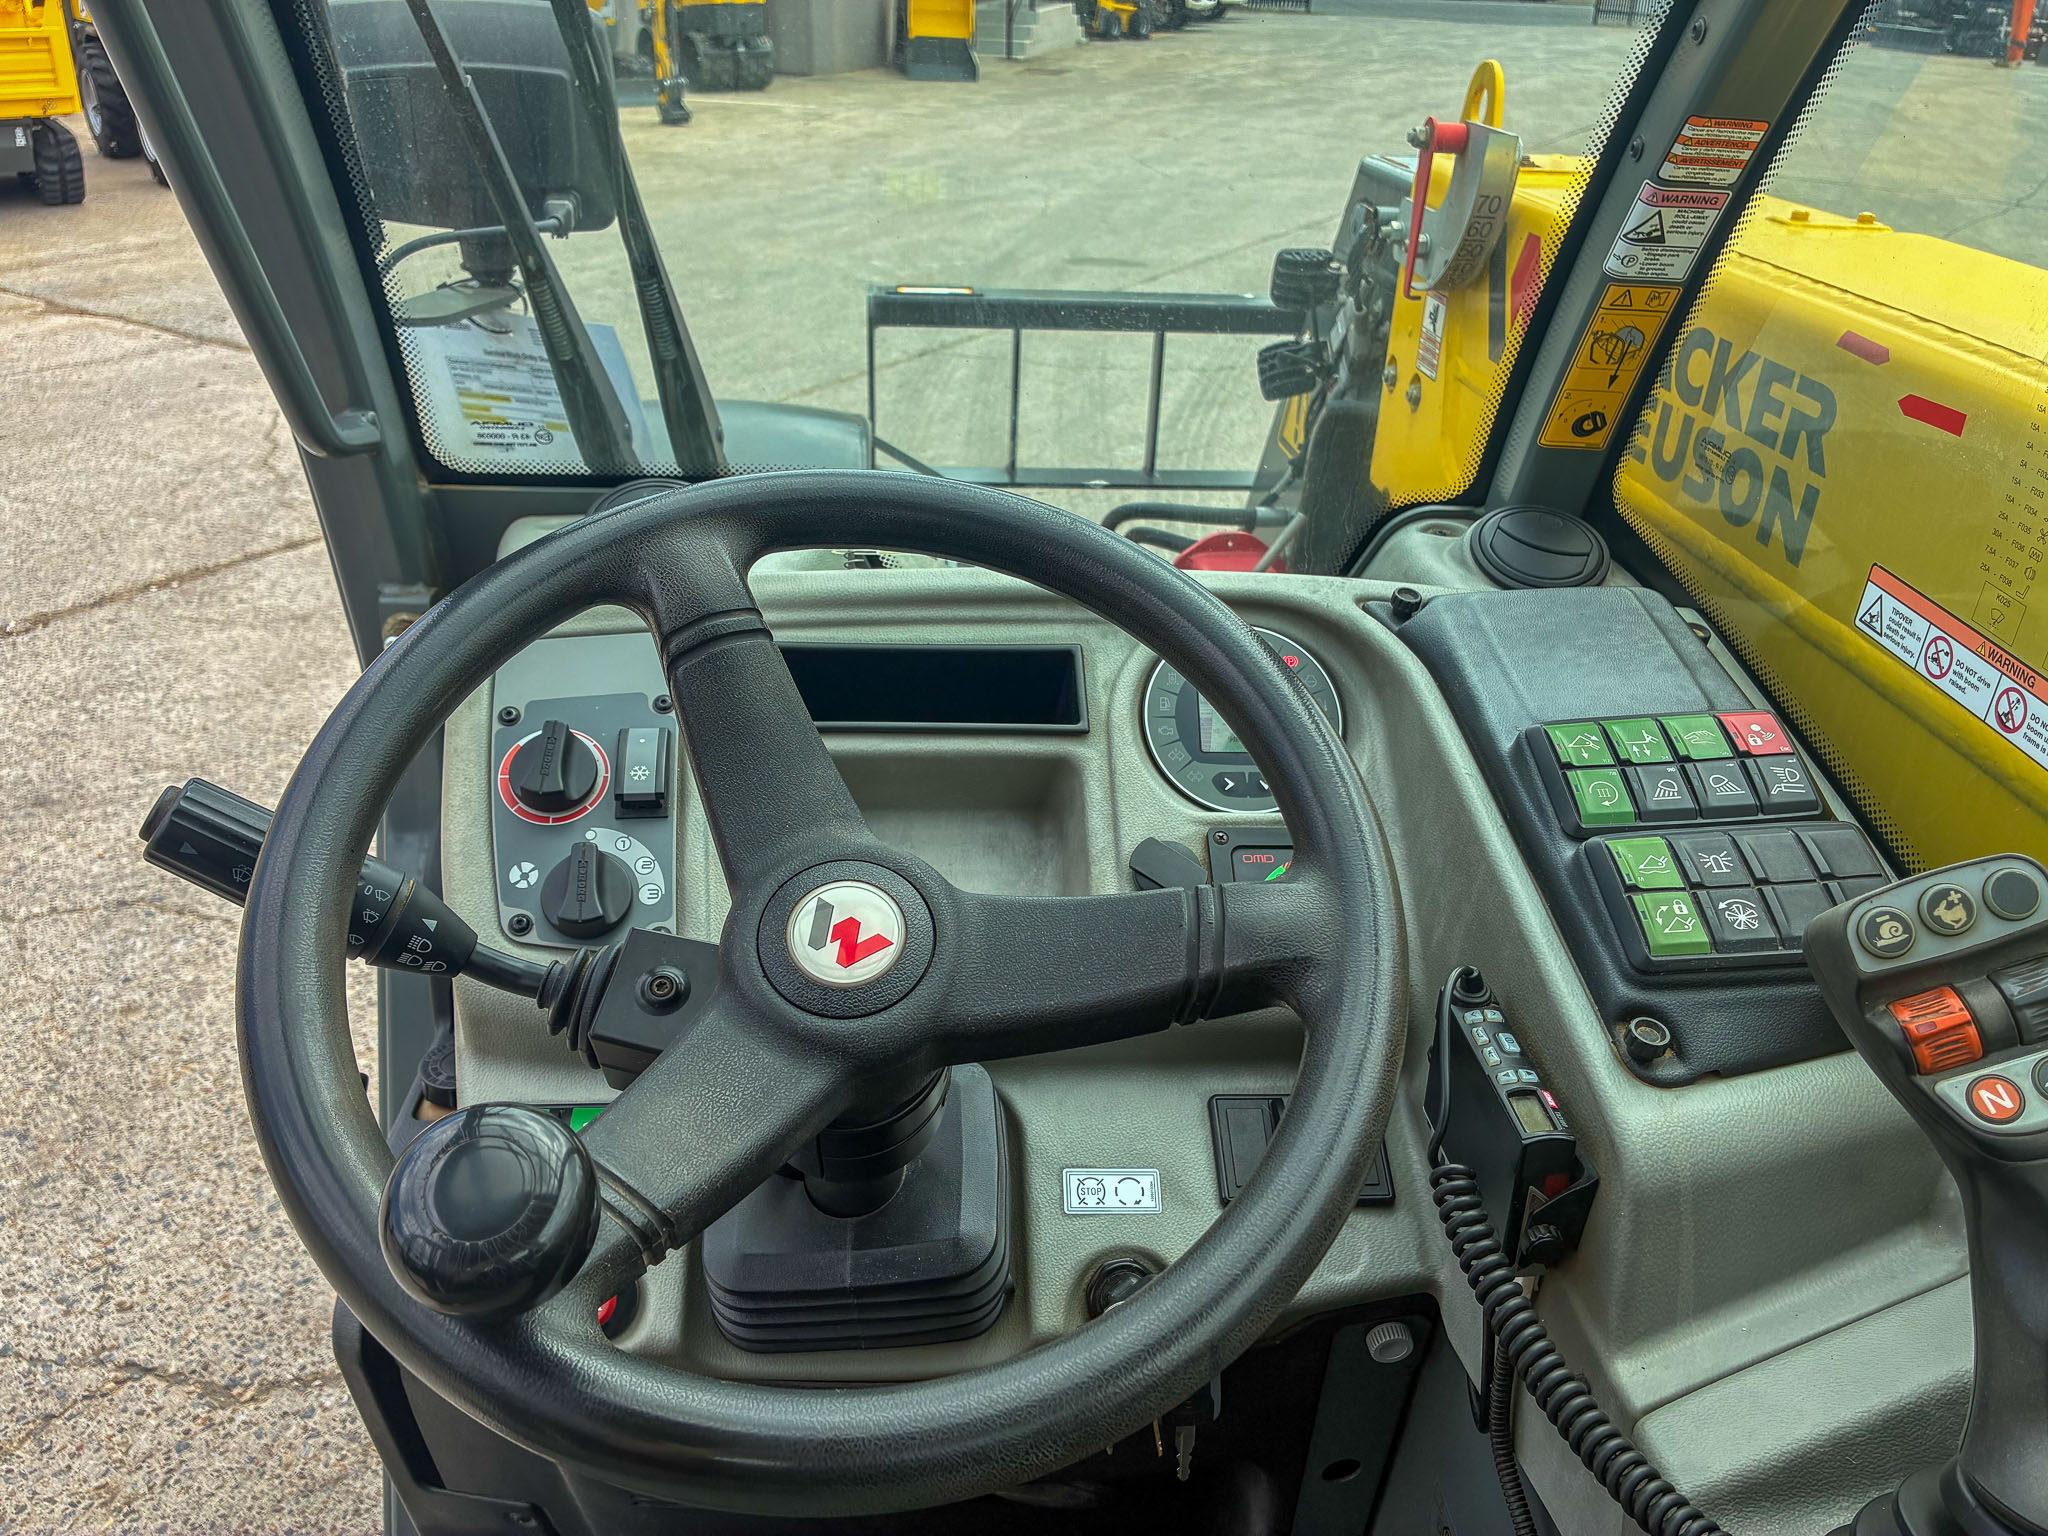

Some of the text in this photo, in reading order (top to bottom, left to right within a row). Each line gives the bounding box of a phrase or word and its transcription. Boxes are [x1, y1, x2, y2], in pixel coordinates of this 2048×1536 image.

[1714, 120, 1754, 128] WARNING
[1694, 140, 1750, 148] ADVERTENCIA
[1477, 194, 1502, 214] 70
[1661, 194, 1720, 206] WARNING
[1468, 221, 1492, 238] 60
[2026, 442, 2034, 450] 5A
[2020, 460, 2028, 469] 5A
[2012, 476, 2044, 499] 15A F033
[2006, 494, 2038, 516] 15A F034
[1998, 511, 2032, 535] 25A F035
[1992, 528, 2025, 553] 30A F036
[2005, 556, 2019, 570] F037
[1980, 562, 2012, 588] 25A F038
[1996, 594, 2011, 608] K025
[1891, 606, 1912, 626] TIPOVER
[1886, 624, 1900, 638] death
[1888, 616, 1922, 643] could result in
[1884, 632, 1914, 658] serious injury.
[1956, 659, 1990, 688] DO NOT drive
[1988, 646, 2036, 689] WARNING
[1948, 678, 1966, 694] raised.
[1952, 669, 1980, 692] with boom
[2030, 712, 2040, 724] DO
[2026, 722, 2044, 740] boom
[2022, 732, 2040, 750] frame
[620, 840, 626, 848] 1
[642, 860, 652, 870] 2
[648, 888, 660, 900] 3
[1978, 1084, 2014, 1114] N
[1080, 1187, 1102, 1196] STOP
